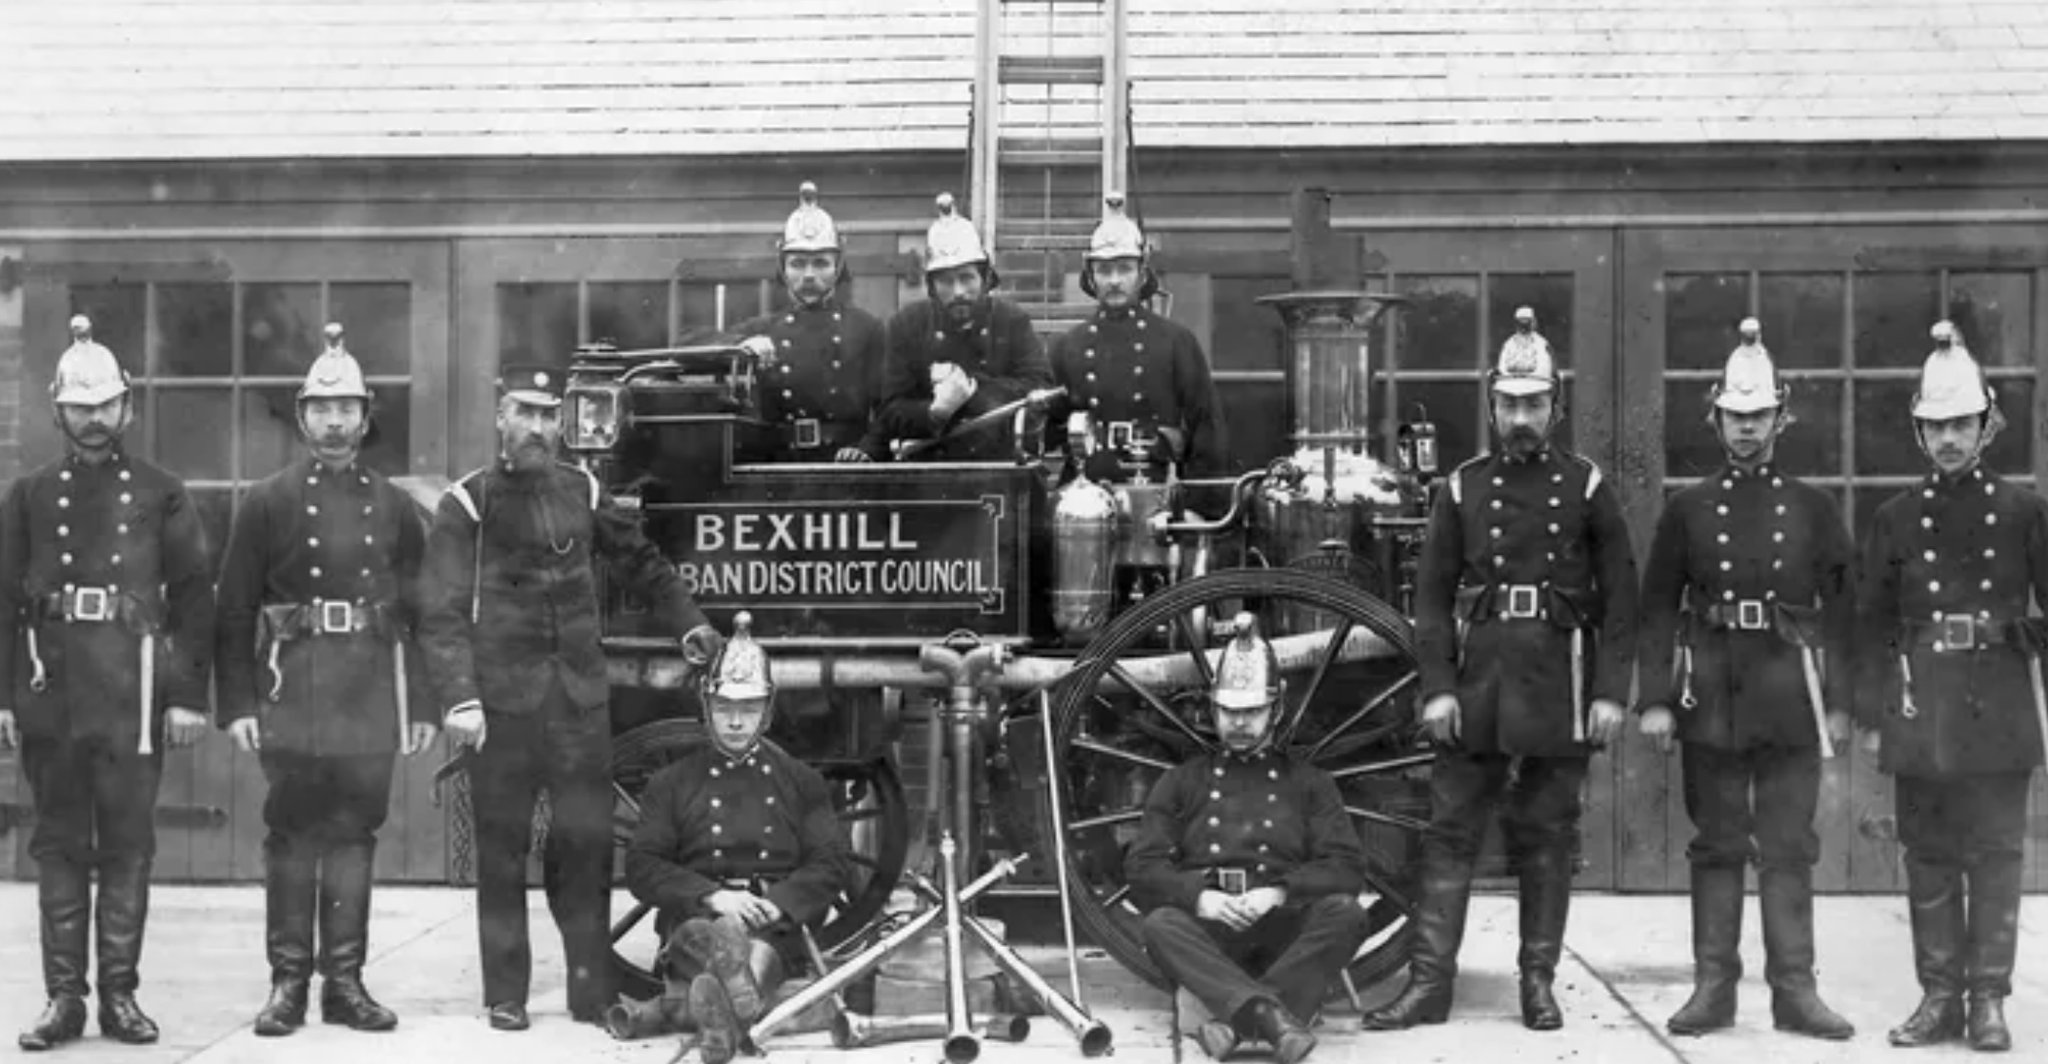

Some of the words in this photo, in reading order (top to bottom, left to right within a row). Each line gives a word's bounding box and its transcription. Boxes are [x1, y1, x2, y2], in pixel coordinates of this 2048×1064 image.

[695, 513, 918, 551] BEXHILL
[669, 561, 743, 595] BAN
[749, 560, 878, 595] DISTRICT
[881, 558, 989, 594] COUNCIL
